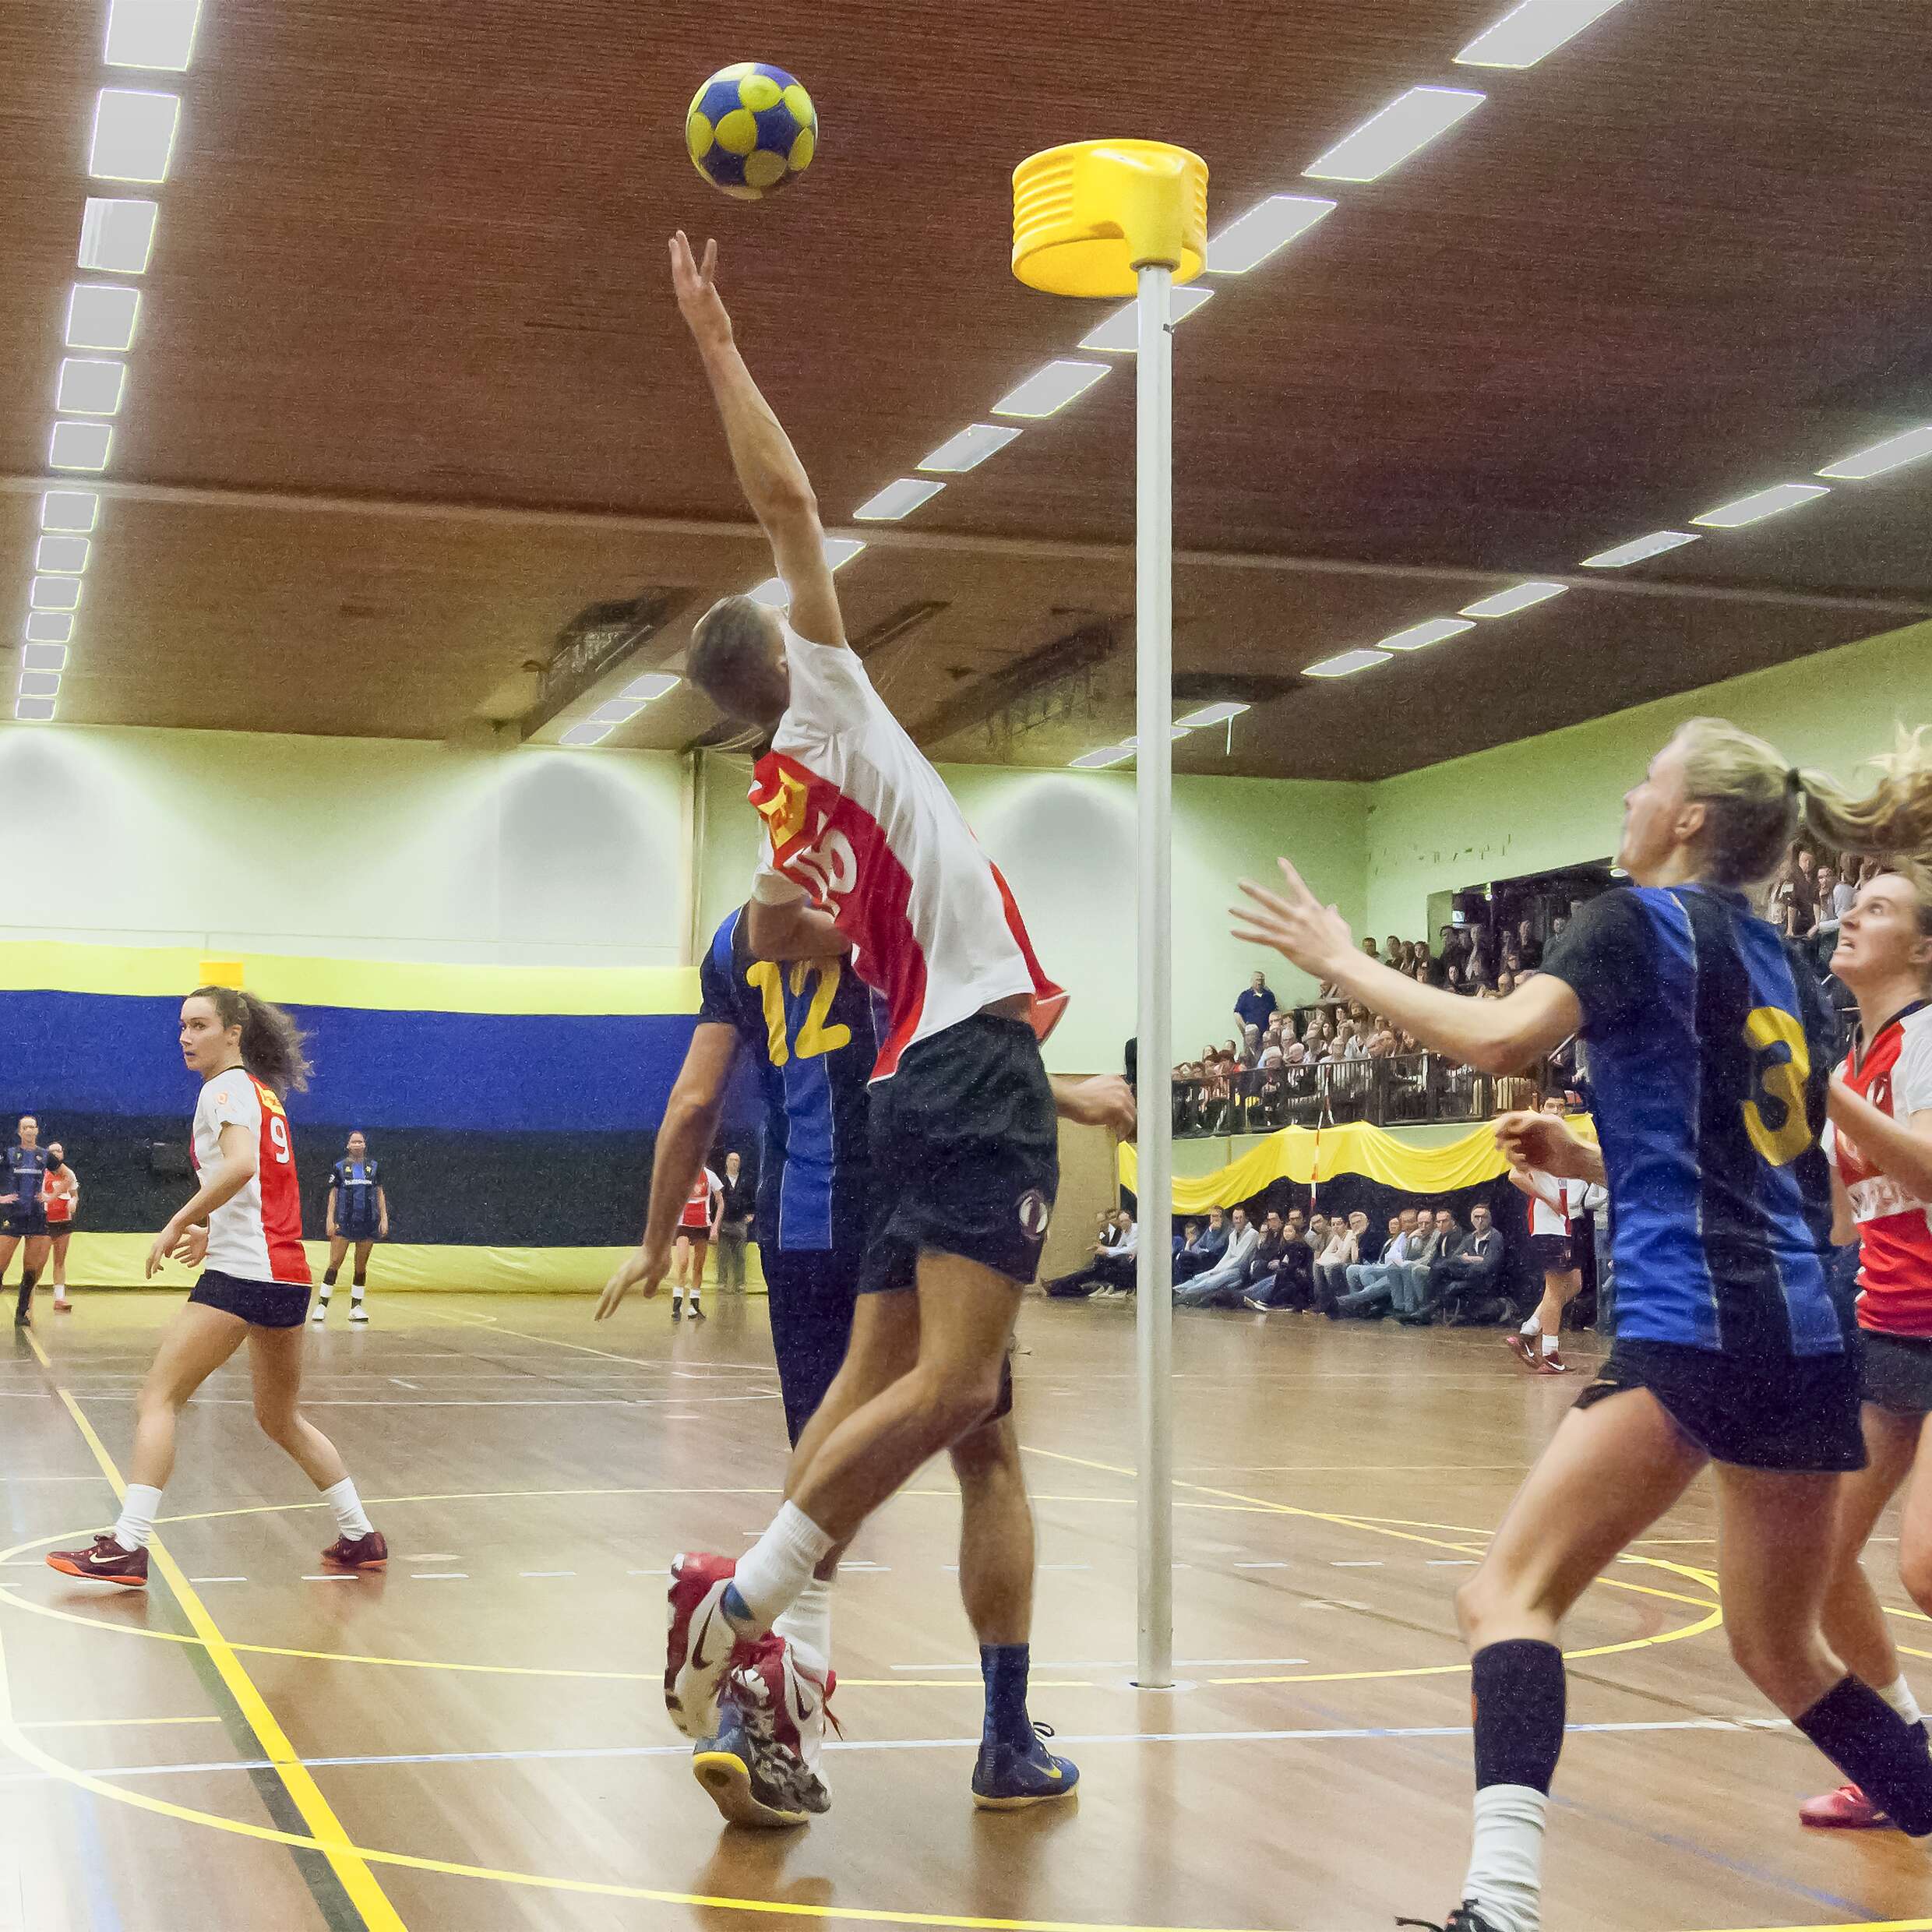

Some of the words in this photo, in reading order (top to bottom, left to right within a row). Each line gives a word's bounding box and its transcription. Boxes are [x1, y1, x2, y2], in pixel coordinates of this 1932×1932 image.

[746, 959, 851, 1066] 12
[1743, 1006, 1812, 1166] 3
[270, 1116, 290, 1164] 9
